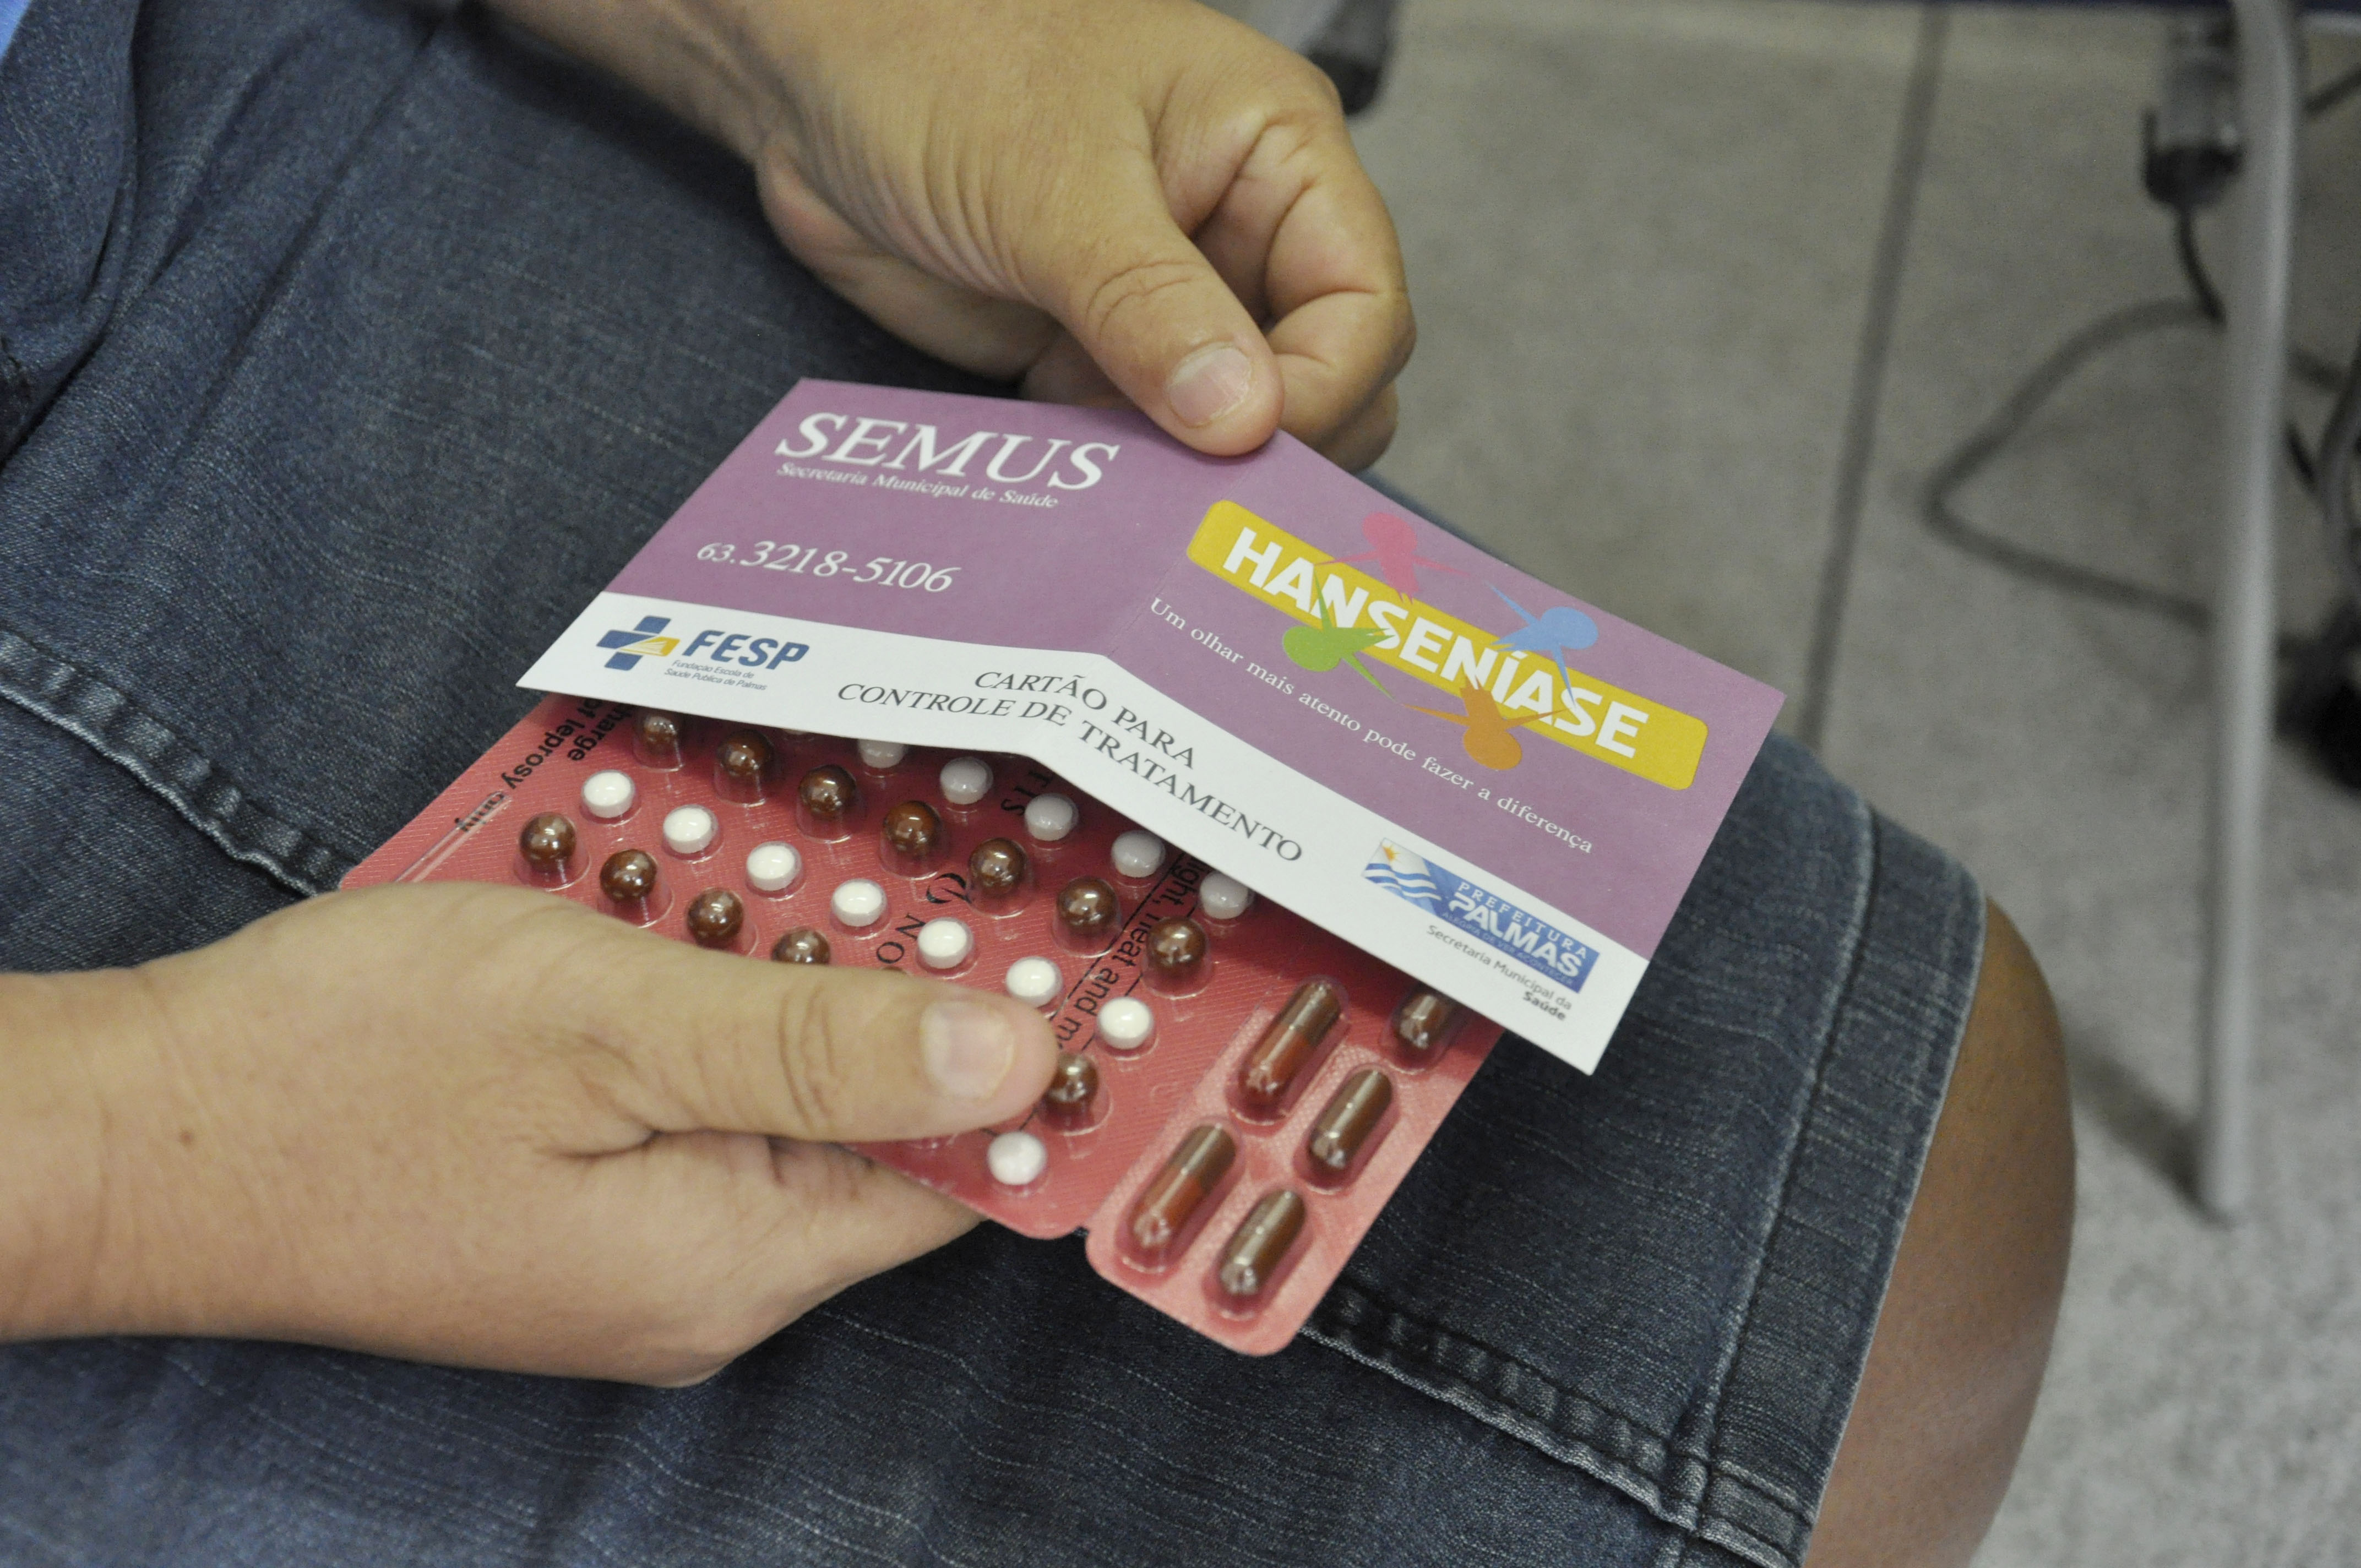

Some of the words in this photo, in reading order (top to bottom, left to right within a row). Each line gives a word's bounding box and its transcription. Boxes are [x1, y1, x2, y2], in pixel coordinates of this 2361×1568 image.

[775, 412, 1120, 491] SEMUS
[777, 462, 868, 486] Secretaria
[872, 473, 969, 497] Municipal
[971, 487, 995, 502] de
[999, 489, 1058, 508] Saúde
[682, 629, 810, 670] FESP
[714, 667, 742, 677] Escola
[1222, 526, 1648, 758] HANSENÍASE
[736, 680, 768, 691] Palmas
[975, 671, 1108, 712] CARTÃO
[1112, 706, 1195, 770] PARA
[502, 718, 585, 790] leprosy
[1151, 597, 1187, 630] Um
[1190, 624, 1244, 663] olhar
[1247, 662, 1295, 695] mais
[1299, 692, 1362, 731] atento
[1362, 729, 1417, 761] pode
[1421, 756, 1474, 790] fazer
[1477, 787, 1492, 801] a
[1497, 797, 1594, 853] diferença
[838, 683, 1016, 717] CONTROLE
[1019, 702, 1072, 726] DE
[1081, 720, 1303, 862] TRATAMENTO
[1448, 891, 1583, 978] PALMAS
[1458, 881, 1587, 959] PREFEITURA
[1074, 967, 1119, 1017] and
[1427, 924, 1492, 966] Secretaria
[1493, 955, 1555, 1001] Municipal
[1556, 994, 1572, 1011] da
[1522, 991, 1566, 1022] Saúde
